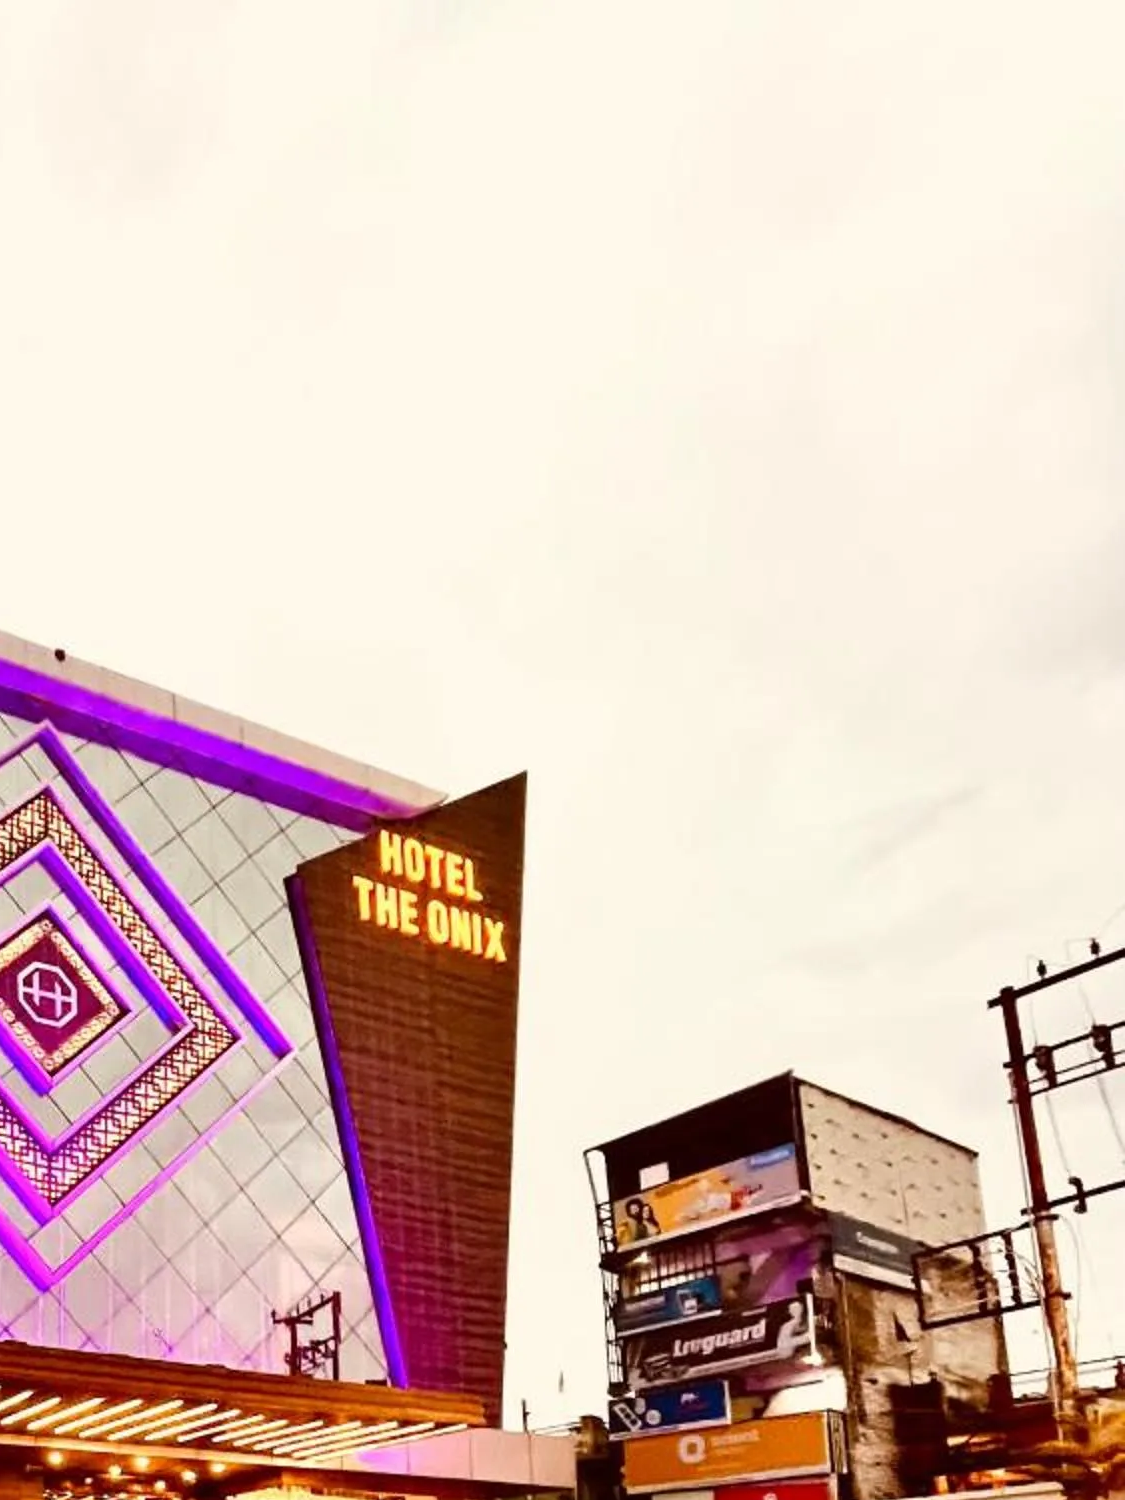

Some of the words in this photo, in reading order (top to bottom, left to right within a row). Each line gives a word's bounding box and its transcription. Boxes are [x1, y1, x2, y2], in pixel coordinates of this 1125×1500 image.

[379, 829, 483, 902] HOTEL
[352, 875, 420, 936] THE
[427, 899, 508, 963] ONIX
